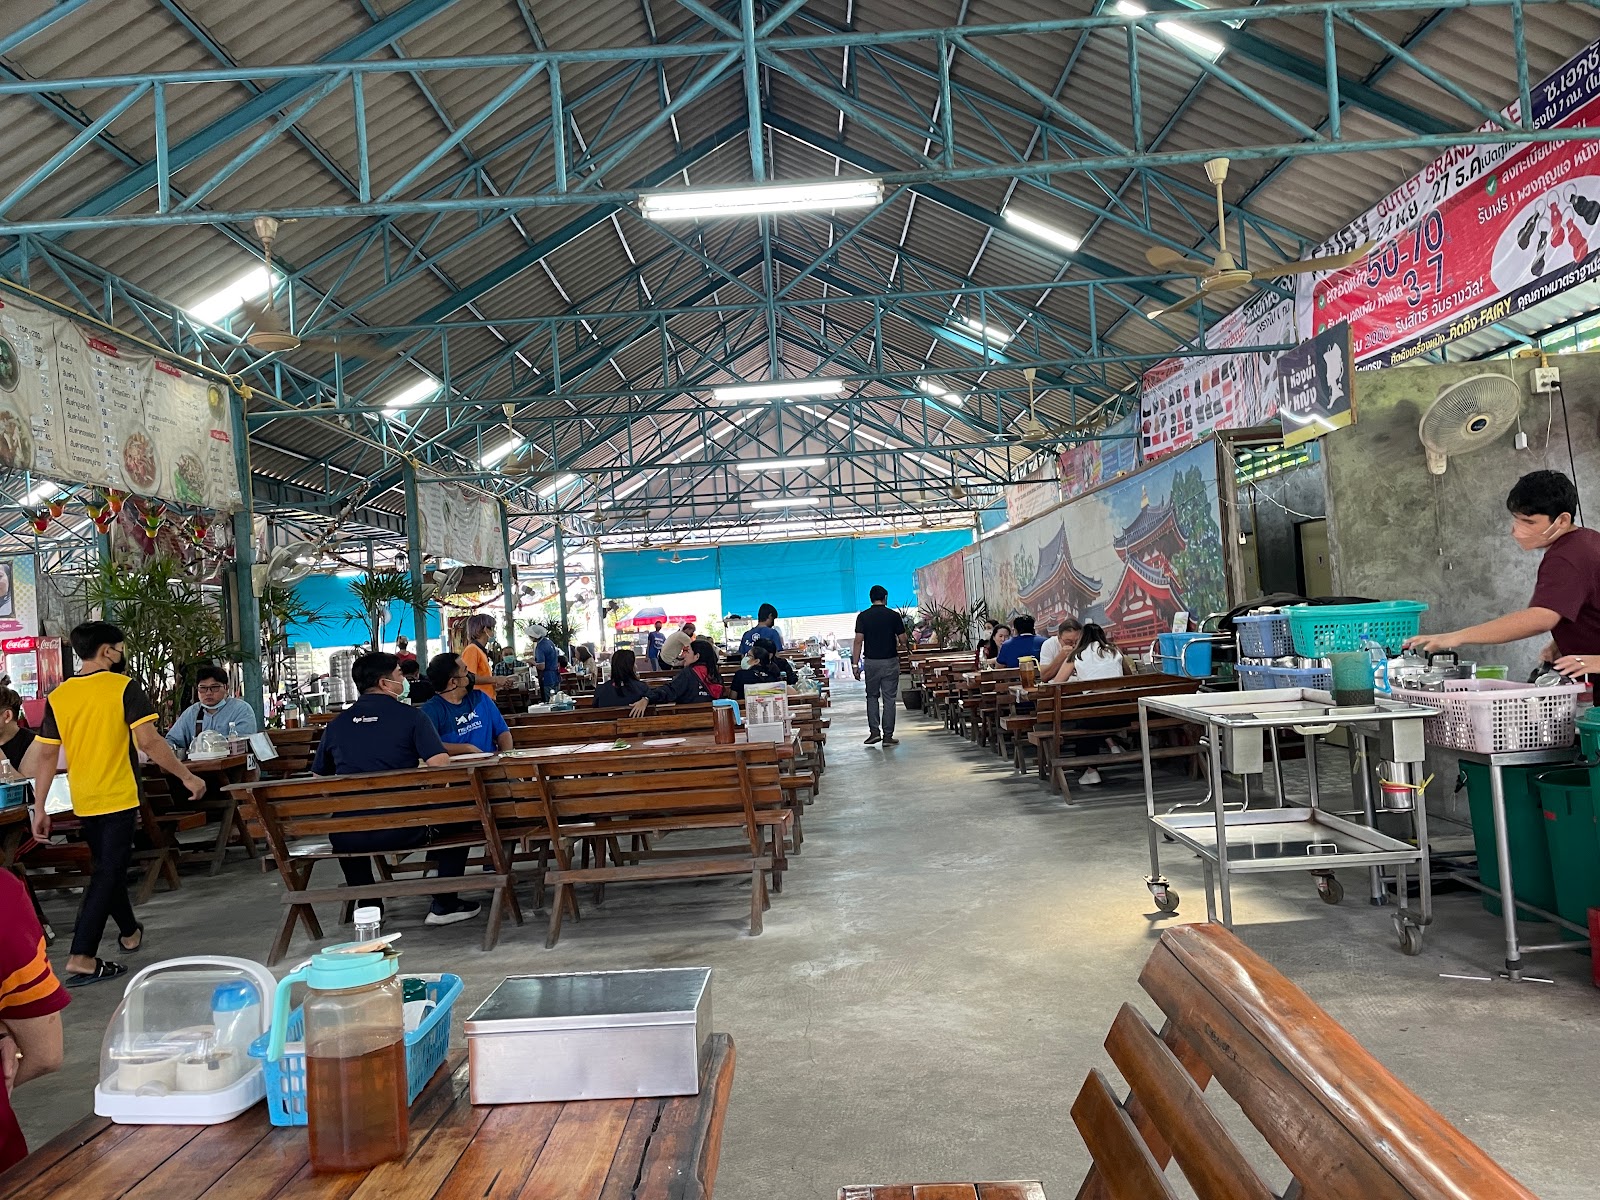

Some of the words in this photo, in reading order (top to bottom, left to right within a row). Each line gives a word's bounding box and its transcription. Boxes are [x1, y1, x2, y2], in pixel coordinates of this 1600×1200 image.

[1533, 103, 1557, 129] รงไป
[1559, 99, 1564, 112] 7
[1377, 174, 1421, 218] OUTLET
[1425, 144, 1477, 185] GRAND
[1478, 194, 1509, 225] รับฟรี
[1517, 159, 1571, 201] พวงกุญแจ
[1574, 141, 1600, 168] หนัง
[1377, 216, 1393, 242] 24
[1432, 172, 1450, 203] 27
[1377, 285, 1404, 309] ท้ายบิล
[1431, 275, 1484, 317] จับรางวัล!
[1480, 297, 1512, 326] FAIRY
[1290, 354, 1316, 389] ห้องน้ำ
[1293, 383, 1317, 413] หญิง
[6, 639, 31, 649] Coca-Cola
[248, 755, 256, 767] 28
